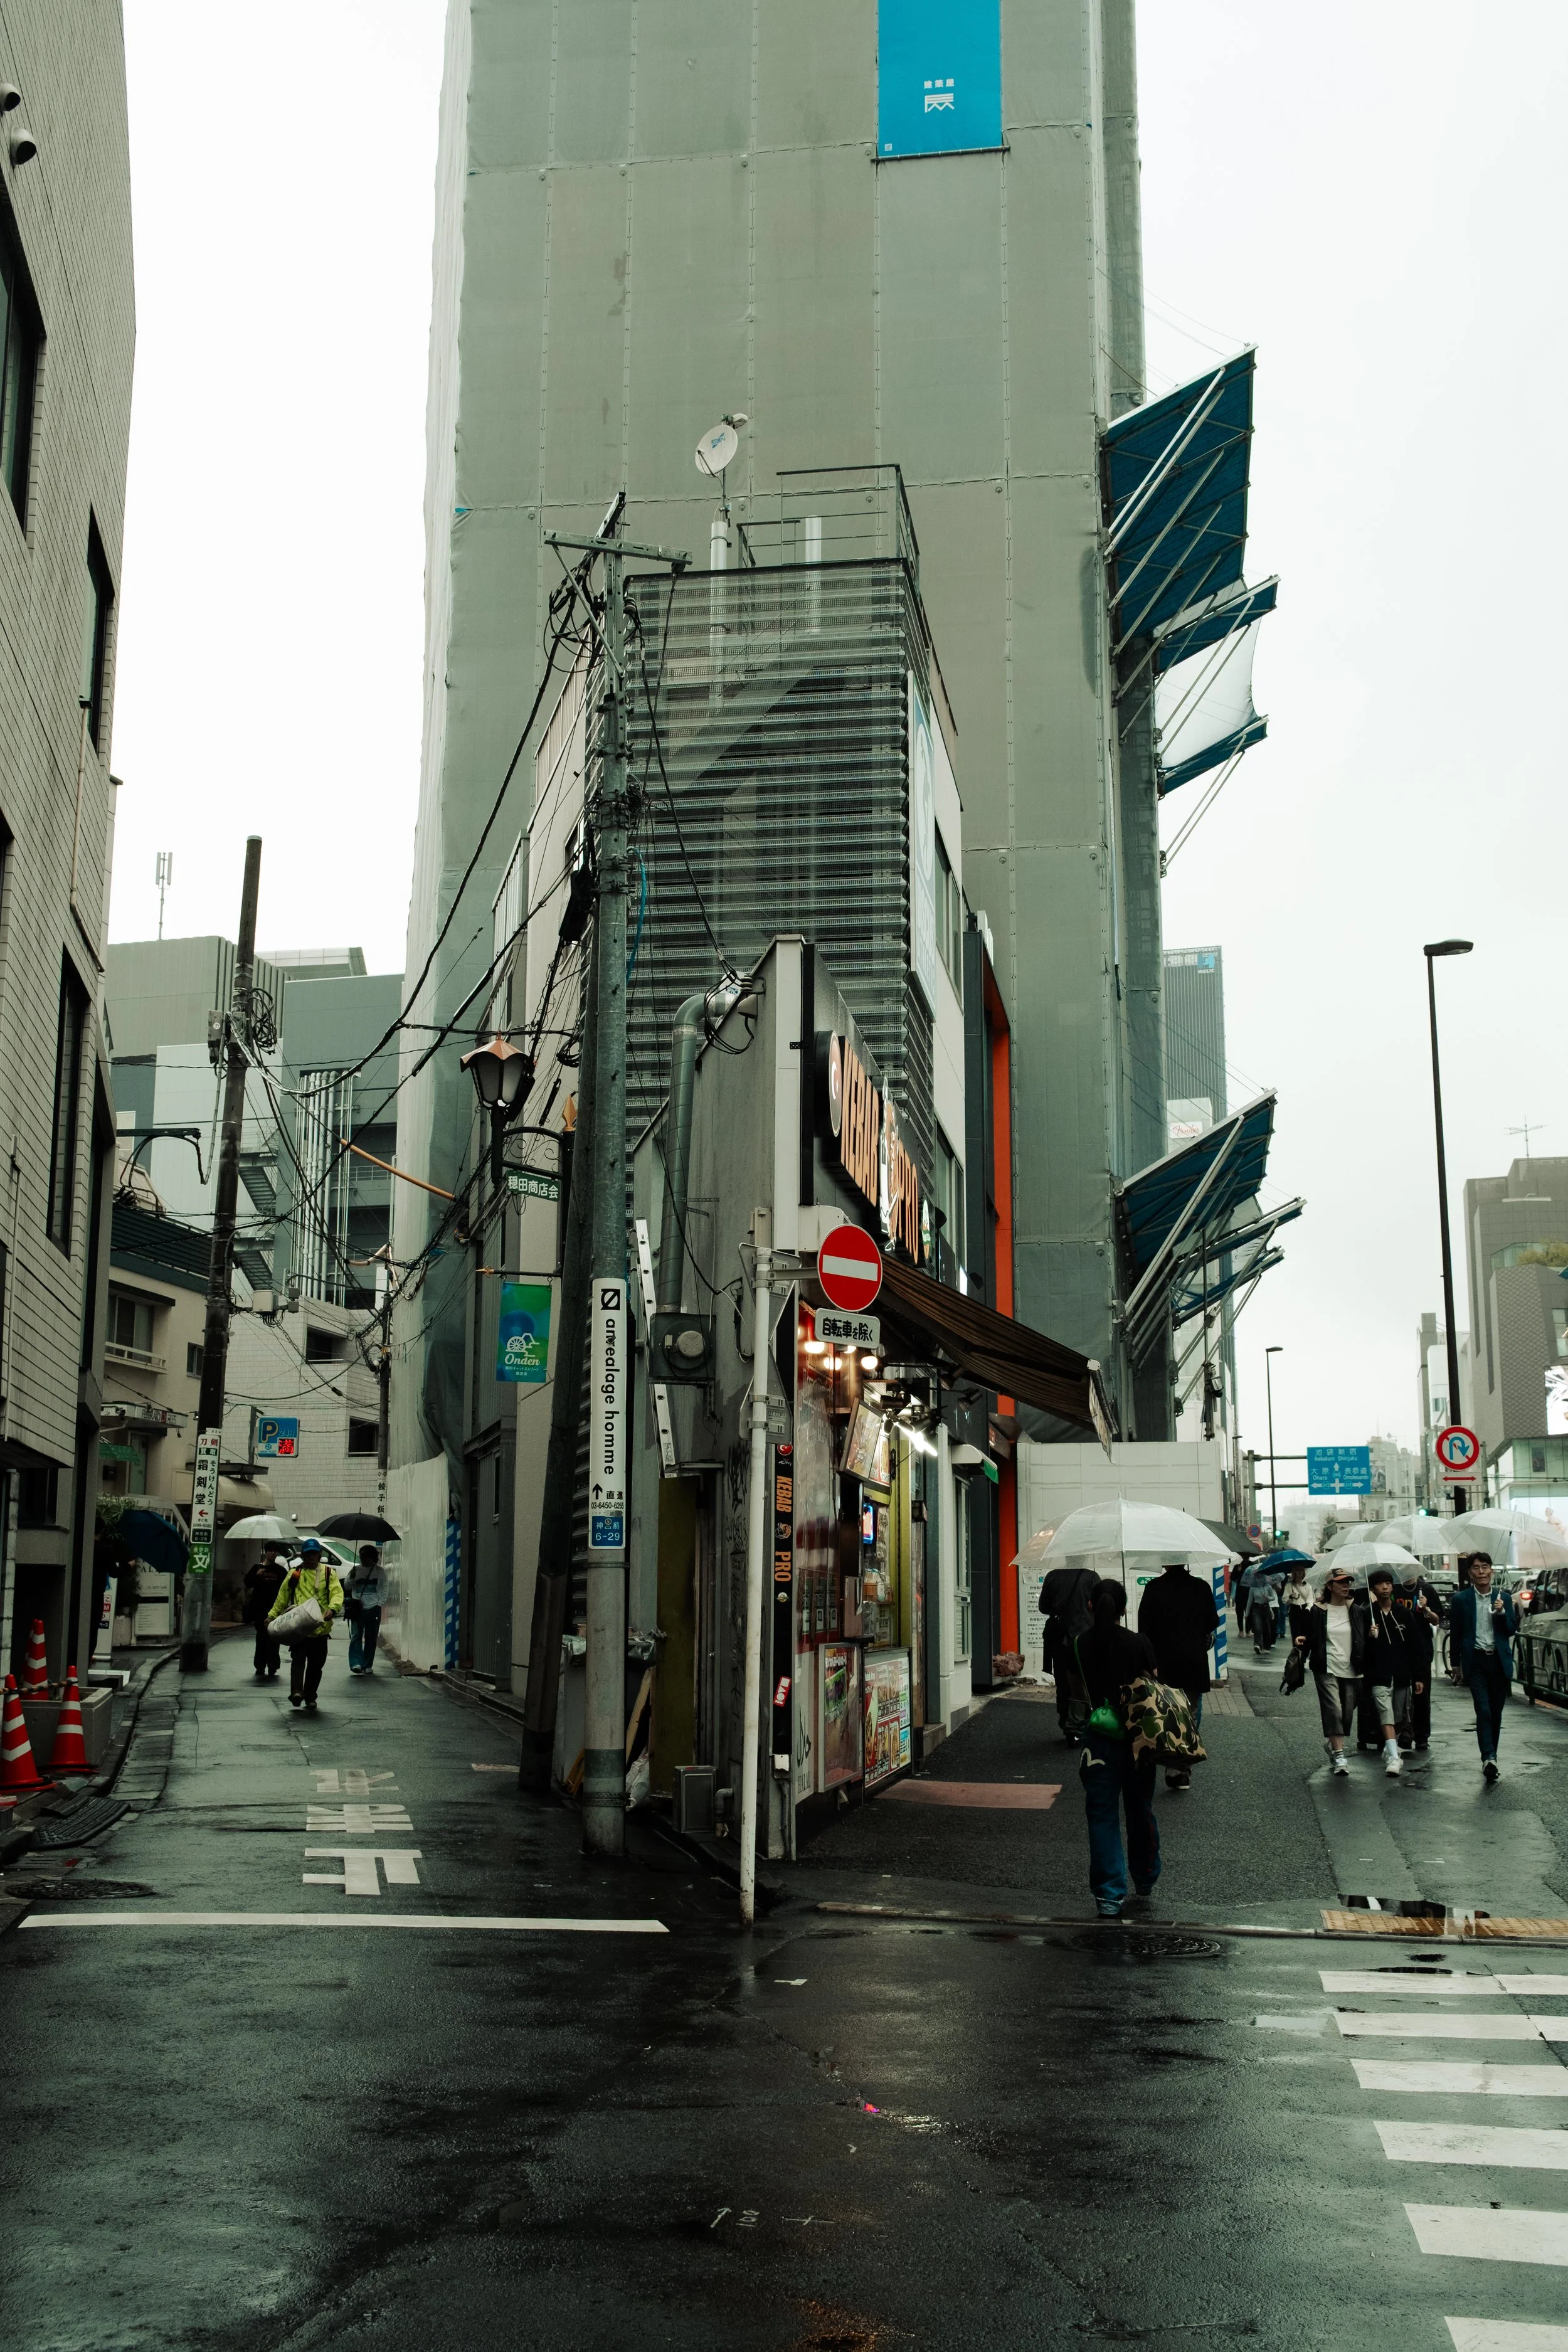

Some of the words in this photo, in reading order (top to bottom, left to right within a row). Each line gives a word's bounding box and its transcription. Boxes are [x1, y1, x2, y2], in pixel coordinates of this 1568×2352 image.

[1172, 1124, 1200, 1136] Fender
[840, 1036, 879, 1207] KEBAB
[898, 1138, 918, 1264] PRO
[822, 1317, 873, 1342] 自転車を除く
[505, 1353, 541, 1366] Onden
[261, 1421, 278, 1443] P
[604, 1411, 620, 1475] homme
[195, 1459, 208, 1505] 霜剣堂
[208, 1460, 216, 1505] そうけんどう
[606, 1490, 623, 1500] 直進
[776, 1475, 793, 1513] KEBAB
[595, 1532, 620, 1540] 6-29
[775, 1550, 792, 1582] PRO
